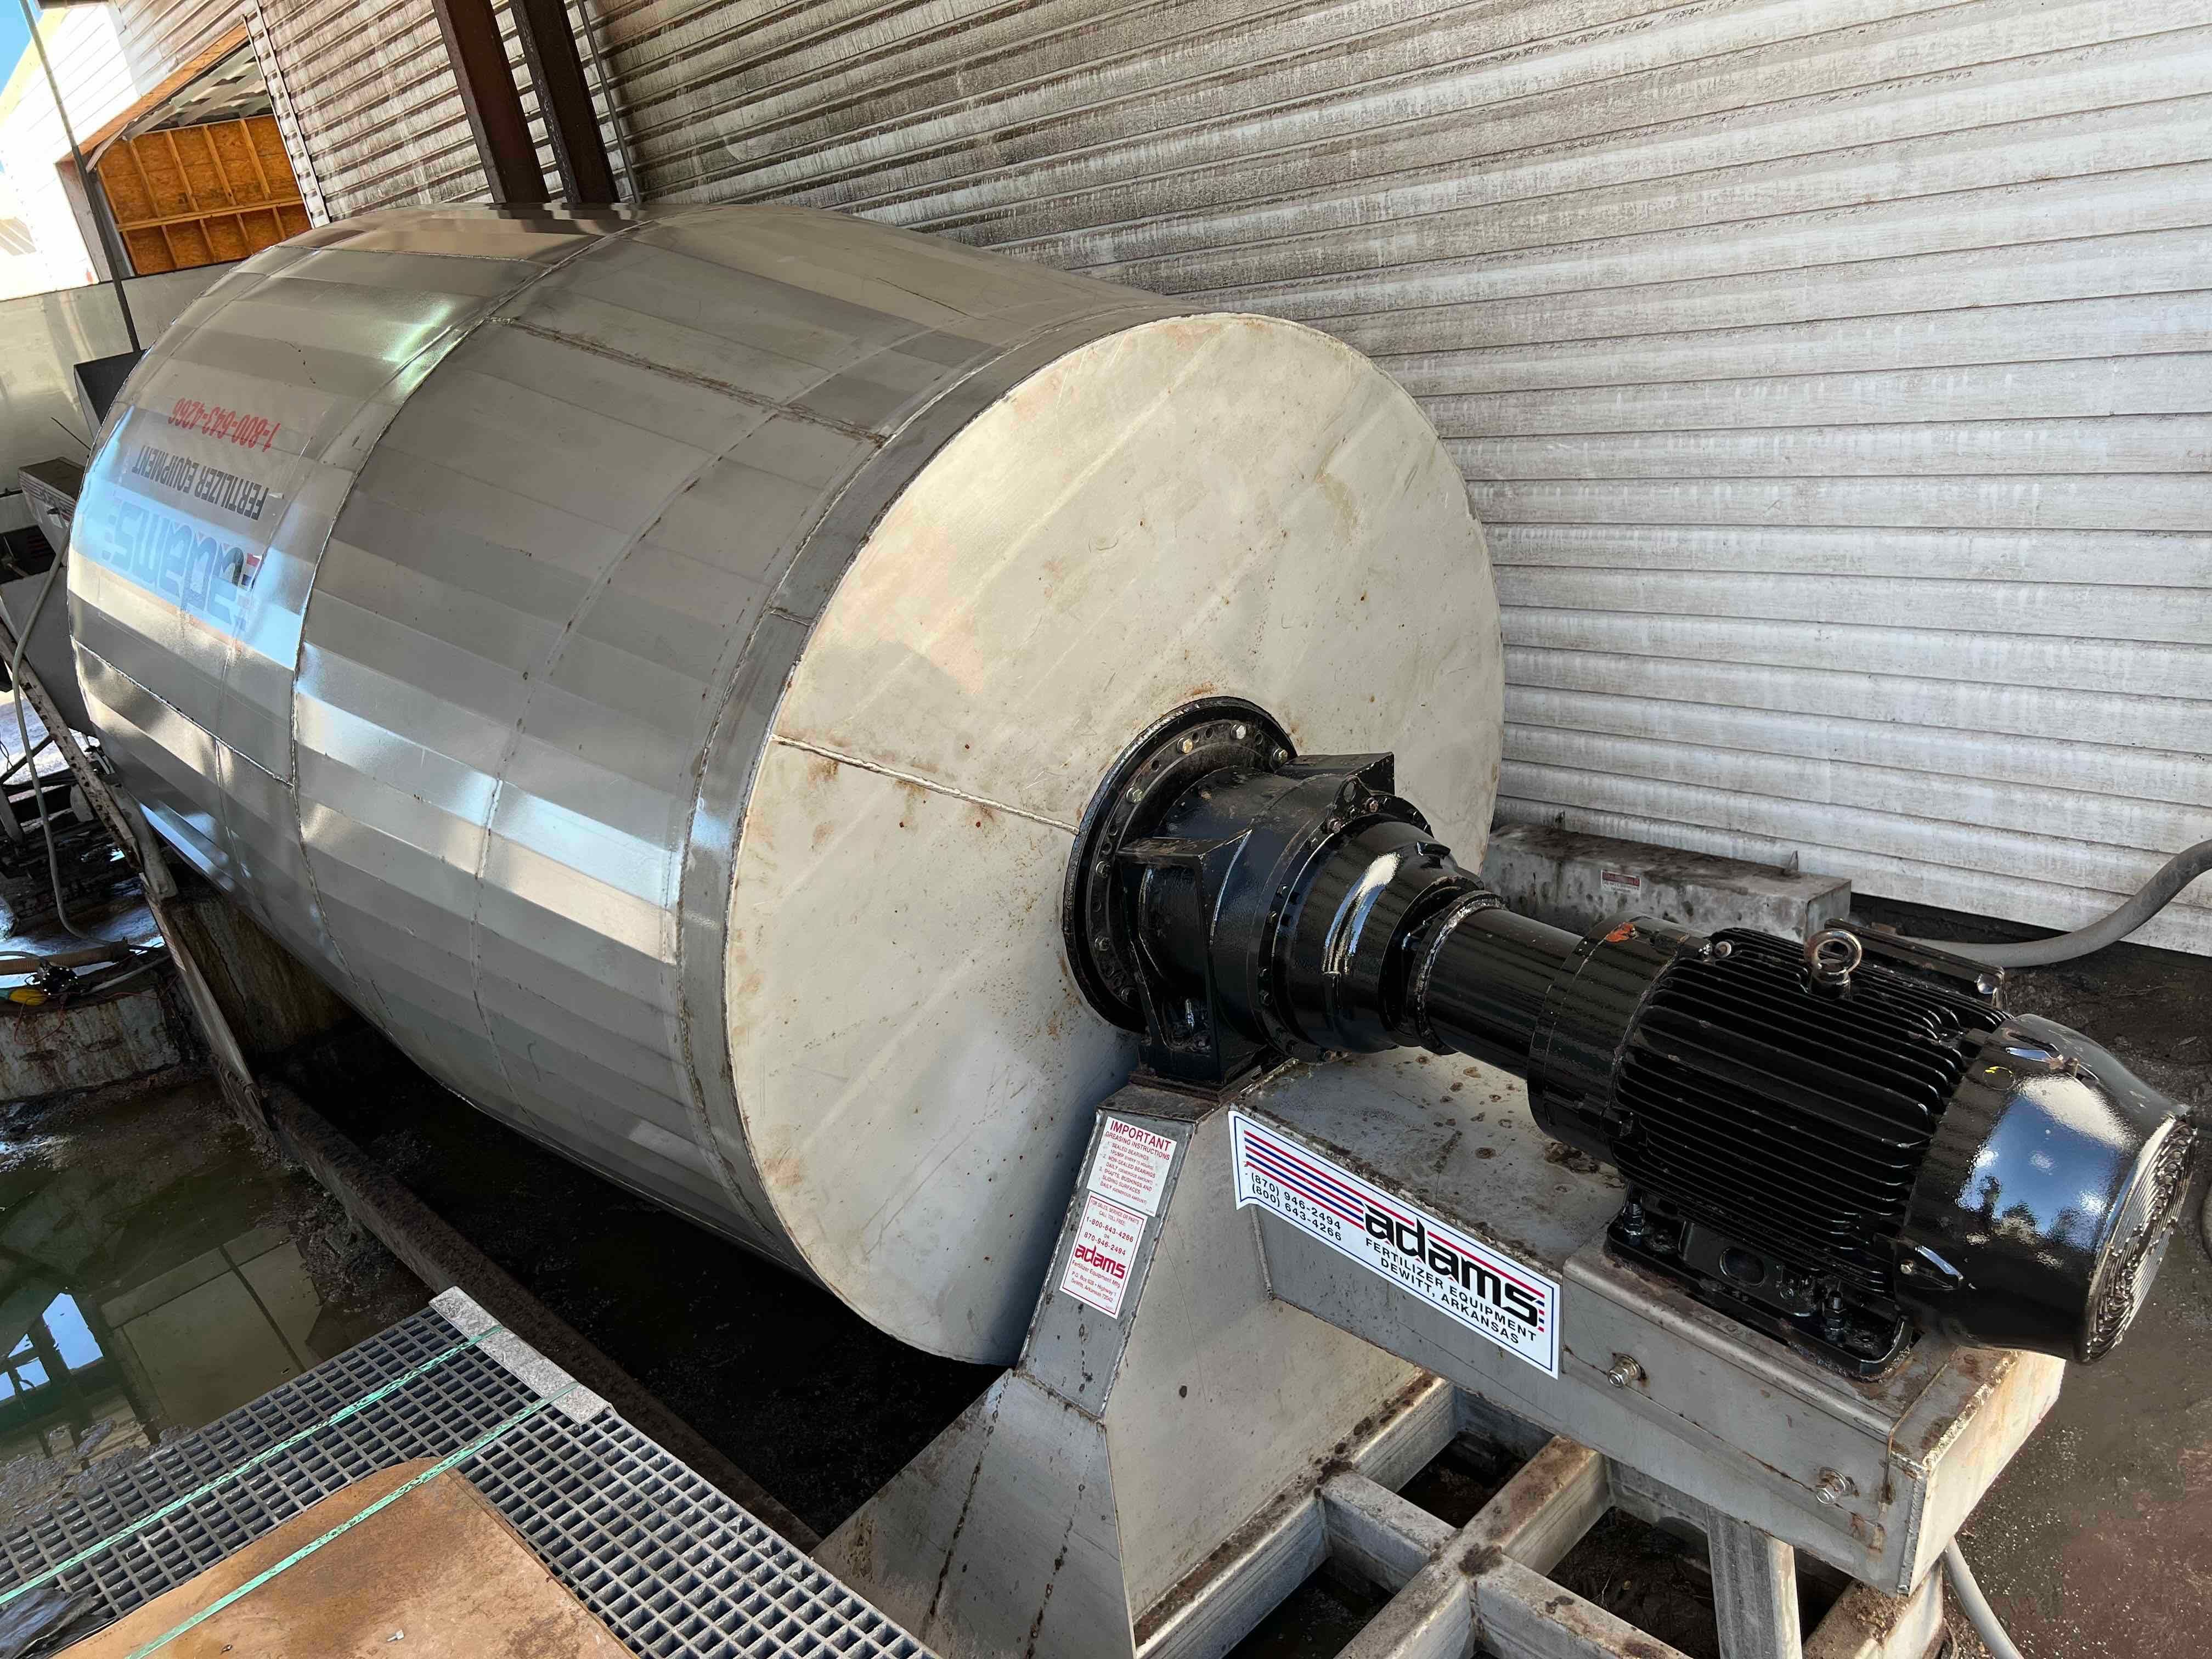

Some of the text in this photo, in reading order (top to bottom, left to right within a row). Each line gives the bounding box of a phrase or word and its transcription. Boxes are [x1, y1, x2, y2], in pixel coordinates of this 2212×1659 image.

[168, 398, 281, 452] 1-800-643-4266
[131, 445, 269, 521] FERTILIZER EQUIPMENT
[1105, 1131, 1170, 1160] GREASING INSTRUCTIONS
[1110, 1120, 1171, 1152] IMPORTANT
[1111, 1142, 1127, 1152] SEALED
[1127, 1149, 1149, 1160] BEARINGS
[1105, 1162, 1118, 1170] DAILY
[1108, 1155, 1133, 1169] NON-SEALED
[1134, 1166, 1155, 1178] BEARINGS
[1100, 1181, 1112, 1189] DAILY
[1102, 1175, 1140, 1194] SLIDING SURFACES
[1121, 1175, 1142, 1187] BUSHINGS
[1251, 1172, 1341, 1230] (870) 946-2494
[1252, 1183, 1341, 1241] (800) 643-4266
[1085, 1216, 1134, 1243] 1-800-643-4266
[1108, 1207, 1122, 1216] SERVICE
[1128, 1216, 1139, 1224] PARTS
[1084, 1232, 1126, 1256] 870-946-2494
[1071, 1260, 1090, 1272] Fertilizer
[1089, 1268, 1111, 1284] Equipment
[1074, 1244, 1126, 1279] adams
[1364, 1204, 1542, 1328] adams
[1366, 1238, 1536, 1342] FERTILIZER EQUIPMENT
[1381, 1257, 1520, 1345] DEWITT, ARKANSAS
